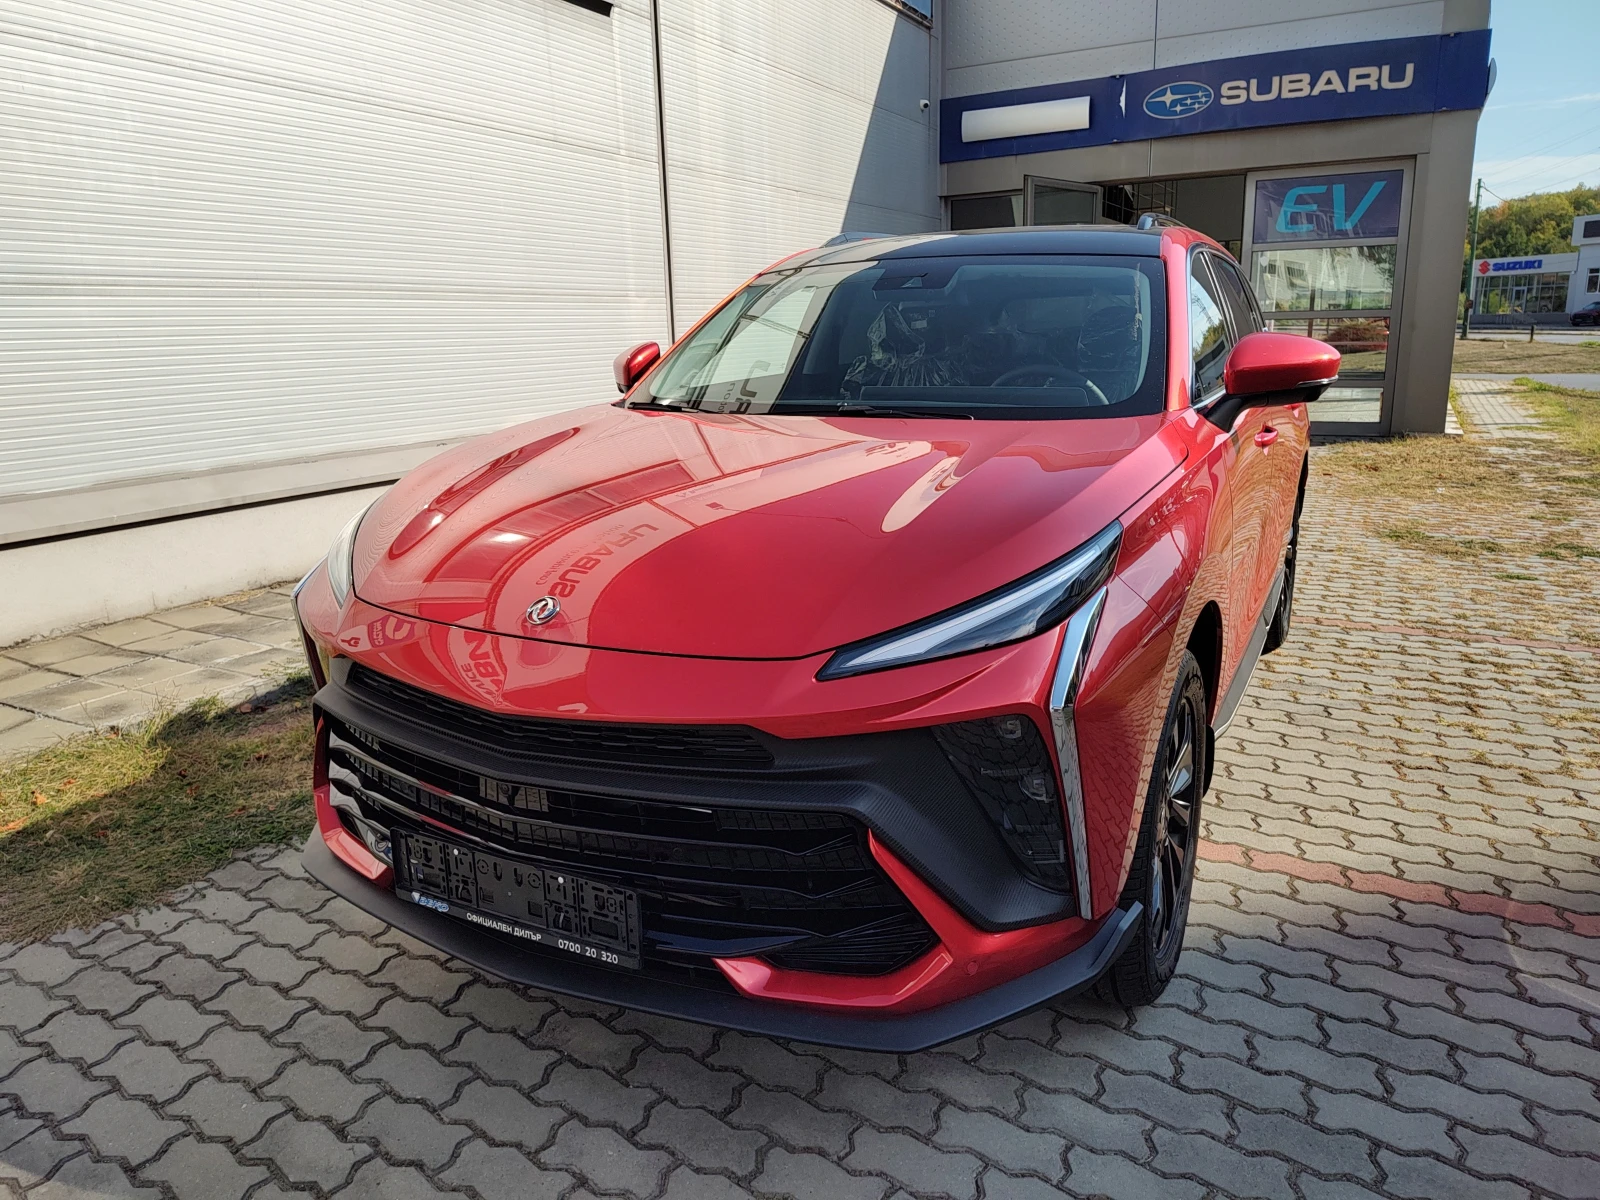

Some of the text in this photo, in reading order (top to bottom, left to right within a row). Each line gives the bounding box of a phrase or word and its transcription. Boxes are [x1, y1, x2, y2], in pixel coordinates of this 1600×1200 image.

[1219, 63, 1414, 106] SUBARU
[1276, 180, 1387, 233] EV
[1492, 259, 1543, 271] SUZUKI
[466, 912, 542, 941] ОФИЦИАЛЕН ДИЛЪР
[557, 939, 619, 965] 0700 20 320
